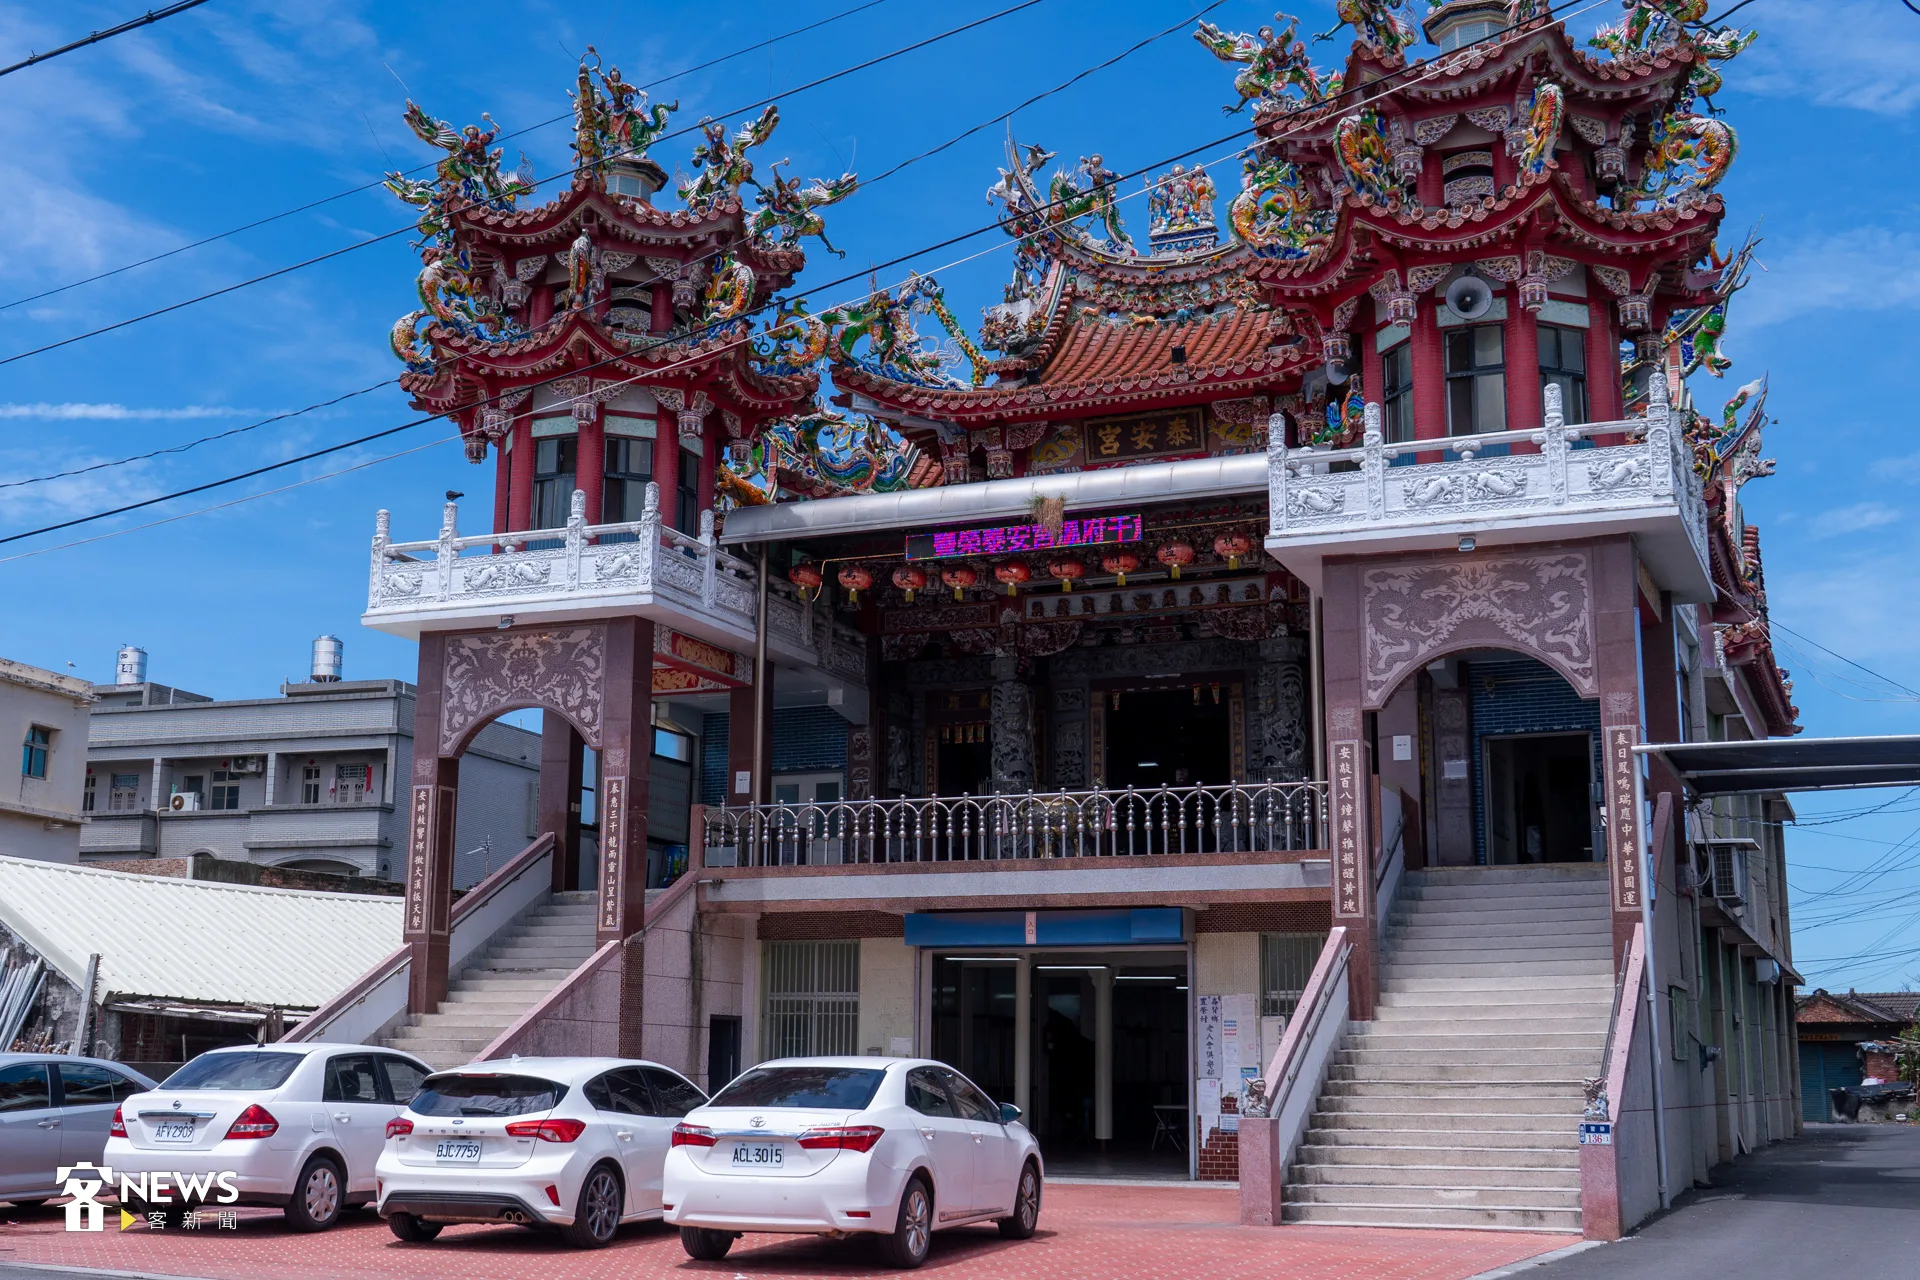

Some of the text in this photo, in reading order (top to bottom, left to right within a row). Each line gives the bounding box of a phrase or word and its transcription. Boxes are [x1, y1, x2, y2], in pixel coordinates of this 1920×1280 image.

[1097, 416, 1193, 455] 泰安宮
[1027, 920, 1034, 935] 入口
[436, 1144, 480, 1158] BJC-7759
[732, 1147, 782, 1163] ACL-3015
